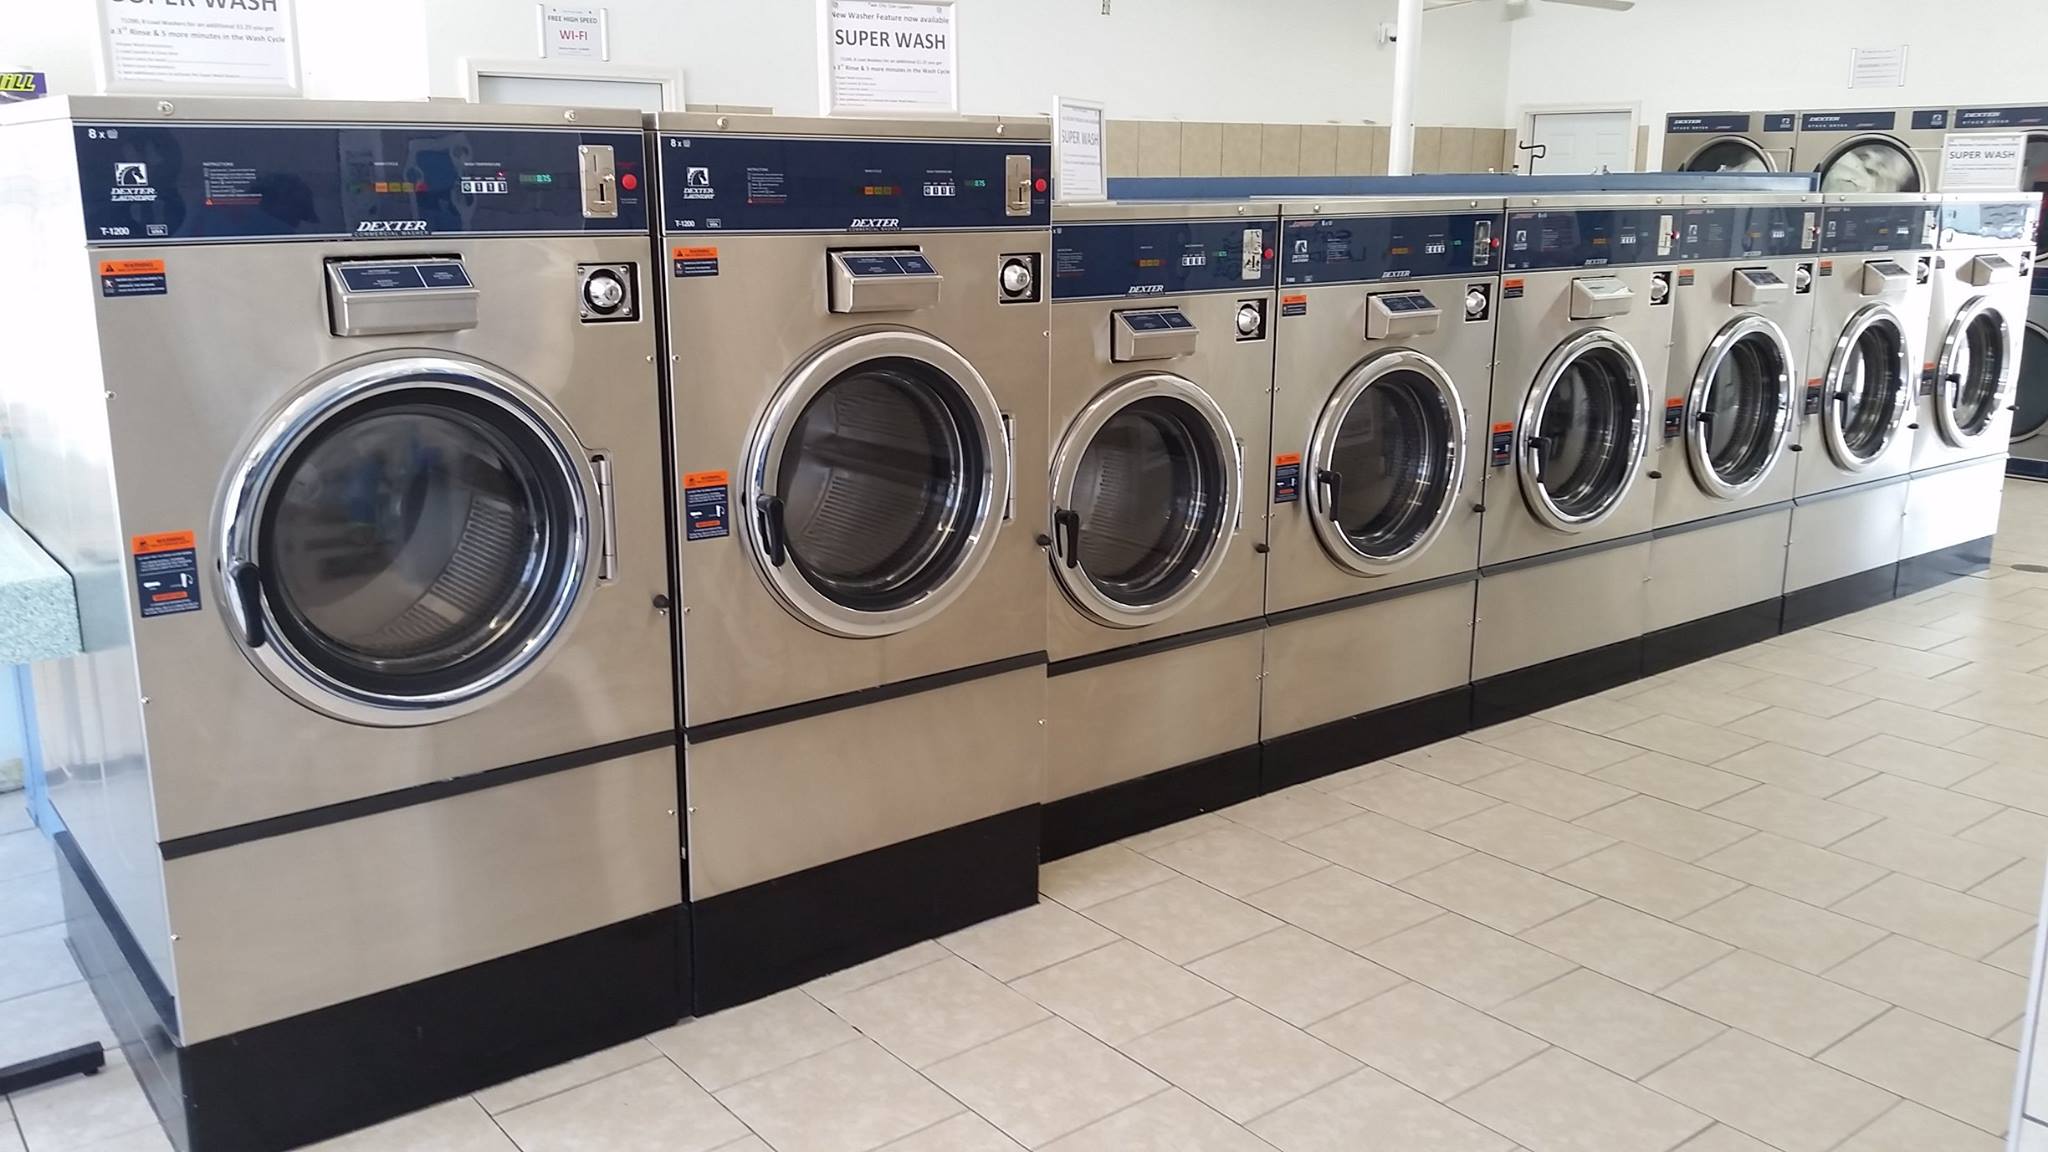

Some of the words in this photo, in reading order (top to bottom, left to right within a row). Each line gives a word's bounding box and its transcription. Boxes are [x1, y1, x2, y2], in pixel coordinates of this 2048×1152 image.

[848, 12, 874, 20] Washer
[876, 13, 902, 22] Feature
[920, 16, 949, 24] available
[190, 32, 221, 40] minutes
[559, 30, 588, 40] WI-FI
[835, 29, 890, 47] SUPER
[895, 32, 946, 50] WASH
[88, 129, 97, 139] 8
[98, 131, 106, 139] x
[1062, 129, 1080, 145] SUPER
[1081, 131, 1099, 146] WASH
[670, 139, 676, 148] 8
[1949, 151, 1981, 159] SUPER
[1984, 151, 2015, 159] WASH
[111, 187, 156, 195] DEXTER
[357, 220, 427, 232] DEXTER
[850, 218, 899, 228] DEXTER
[100, 227, 130, 235] T-1200
[1382, 270, 1411, 278] DEXTER
[1128, 284, 1164, 293] DEXTER
